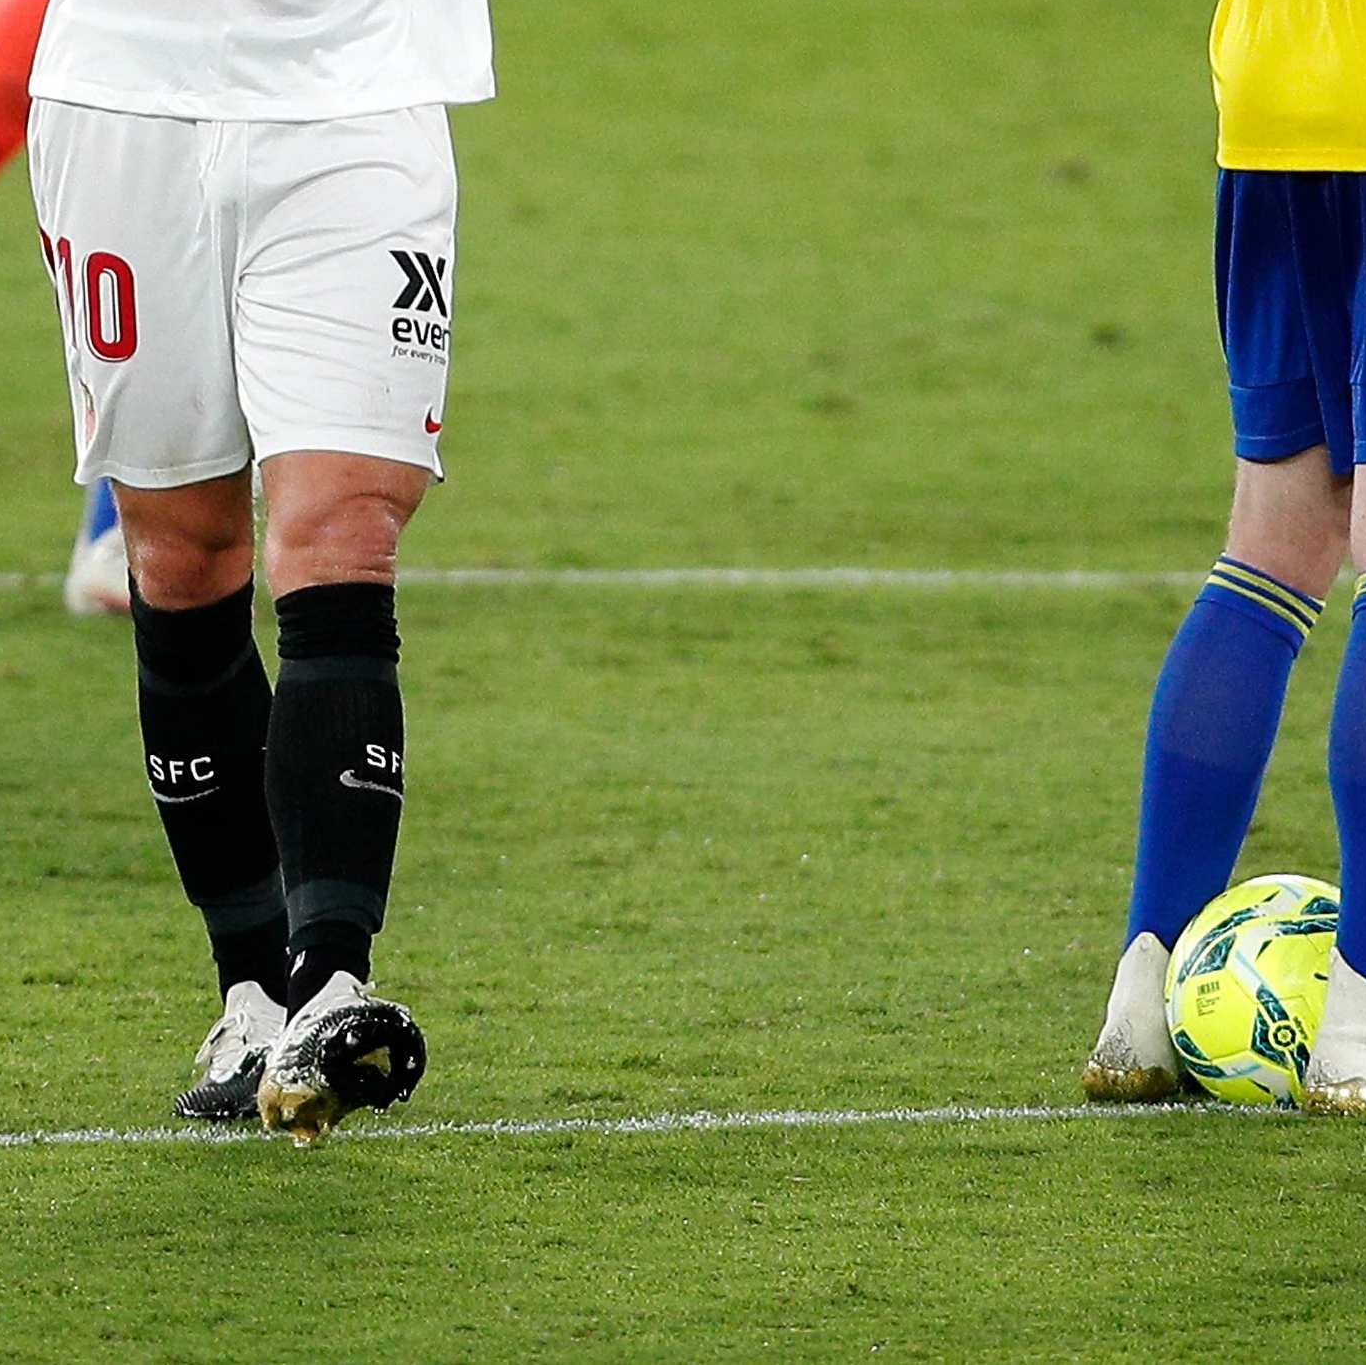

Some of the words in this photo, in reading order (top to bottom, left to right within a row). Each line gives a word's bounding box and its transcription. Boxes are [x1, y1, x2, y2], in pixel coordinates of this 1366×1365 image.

[39, 226, 138, 363] 10
[392, 317, 451, 351] ever
[149, 755, 215, 783] SFC
[366, 744, 402, 773] SF
